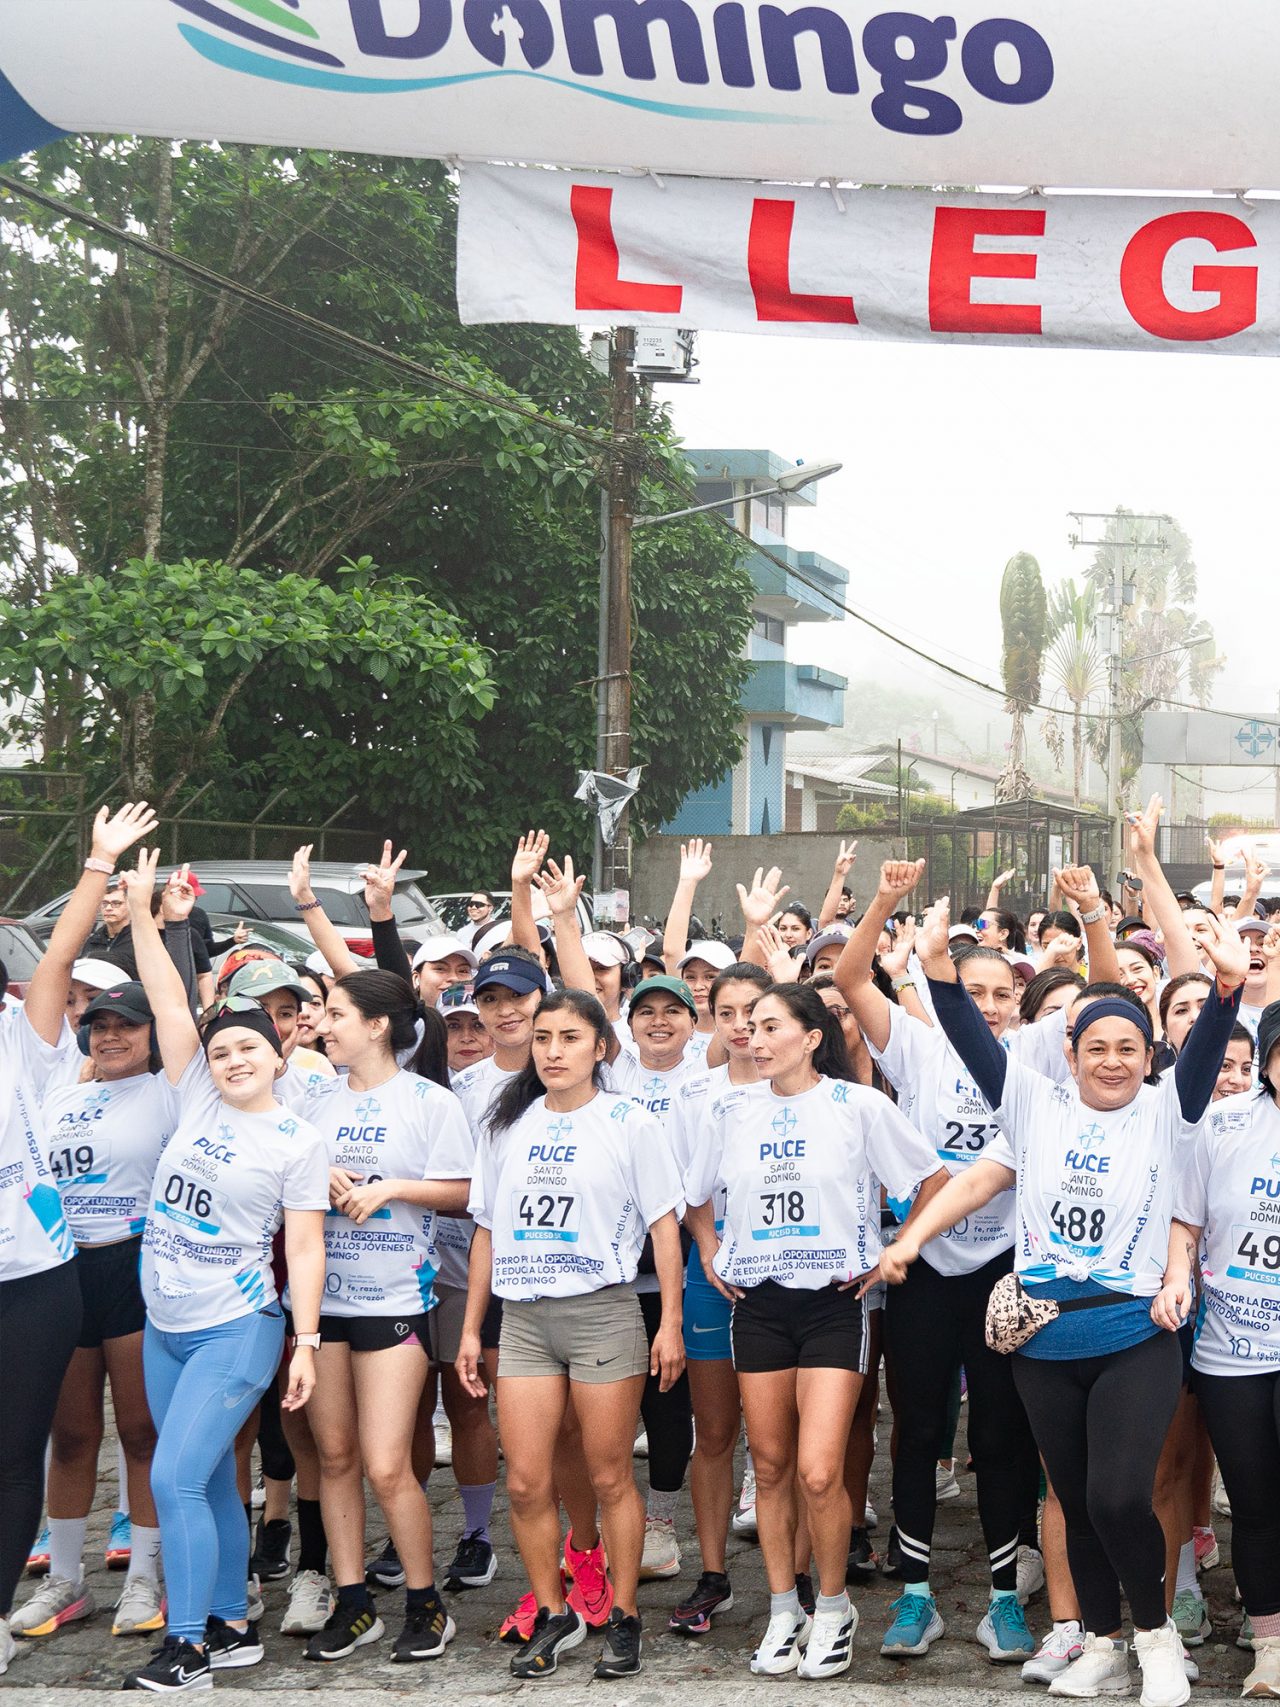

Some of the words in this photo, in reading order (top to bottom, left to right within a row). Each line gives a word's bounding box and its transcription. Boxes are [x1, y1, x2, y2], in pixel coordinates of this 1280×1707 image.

[831, 1083, 853, 1104] 5K
[610, 1101, 634, 1124] 5K
[335, 1126, 387, 1144] PUCE
[193, 1136, 238, 1164] PUCE
[342, 1145, 374, 1154] SANTO
[527, 1144, 578, 1163] PUCE
[759, 1139, 807, 1162] PUCE
[48, 1145, 95, 1179] 419
[190, 1153, 219, 1171] SANTO
[335, 1154, 379, 1165] DOMINGO
[180, 1158, 220, 1183] DOMINGO
[533, 1165, 563, 1175] SANTO
[526, 1176, 568, 1186] DOMINGO
[66, 1196, 136, 1207] OPORTUNIDAD
[164, 1174, 213, 1219] 016
[119, 1207, 133, 1216] DE
[519, 1194, 575, 1228] 427
[759, 1190, 806, 1227] 318
[855, 1177, 872, 1271] pucesd.edu.ec
[1050, 1200, 1106, 1243] 488
[524, 1231, 554, 1240] PUCESD
[342, 1241, 361, 1251] LOS
[361, 1240, 406, 1252] JÓVENES
[784, 1249, 846, 1260] OPORTUNIDAD
[224, 1256, 239, 1266] DE
[743, 1265, 770, 1276] EDUCAR
[778, 1262, 794, 1272] LOS
[794, 1259, 835, 1270] JÓVENES
[835, 1260, 846, 1269] DE
[537, 1265, 557, 1275] LOS
[1244, 1271, 1277, 1284] PUCESD
[1224, 1291, 1246, 1305] POR
[1246, 1296, 1260, 1307] LA
[1224, 1309, 1271, 1332] DOMINGO
[1242, 1306, 1251, 1317] A
[1251, 1308, 1271, 1321] LOS
